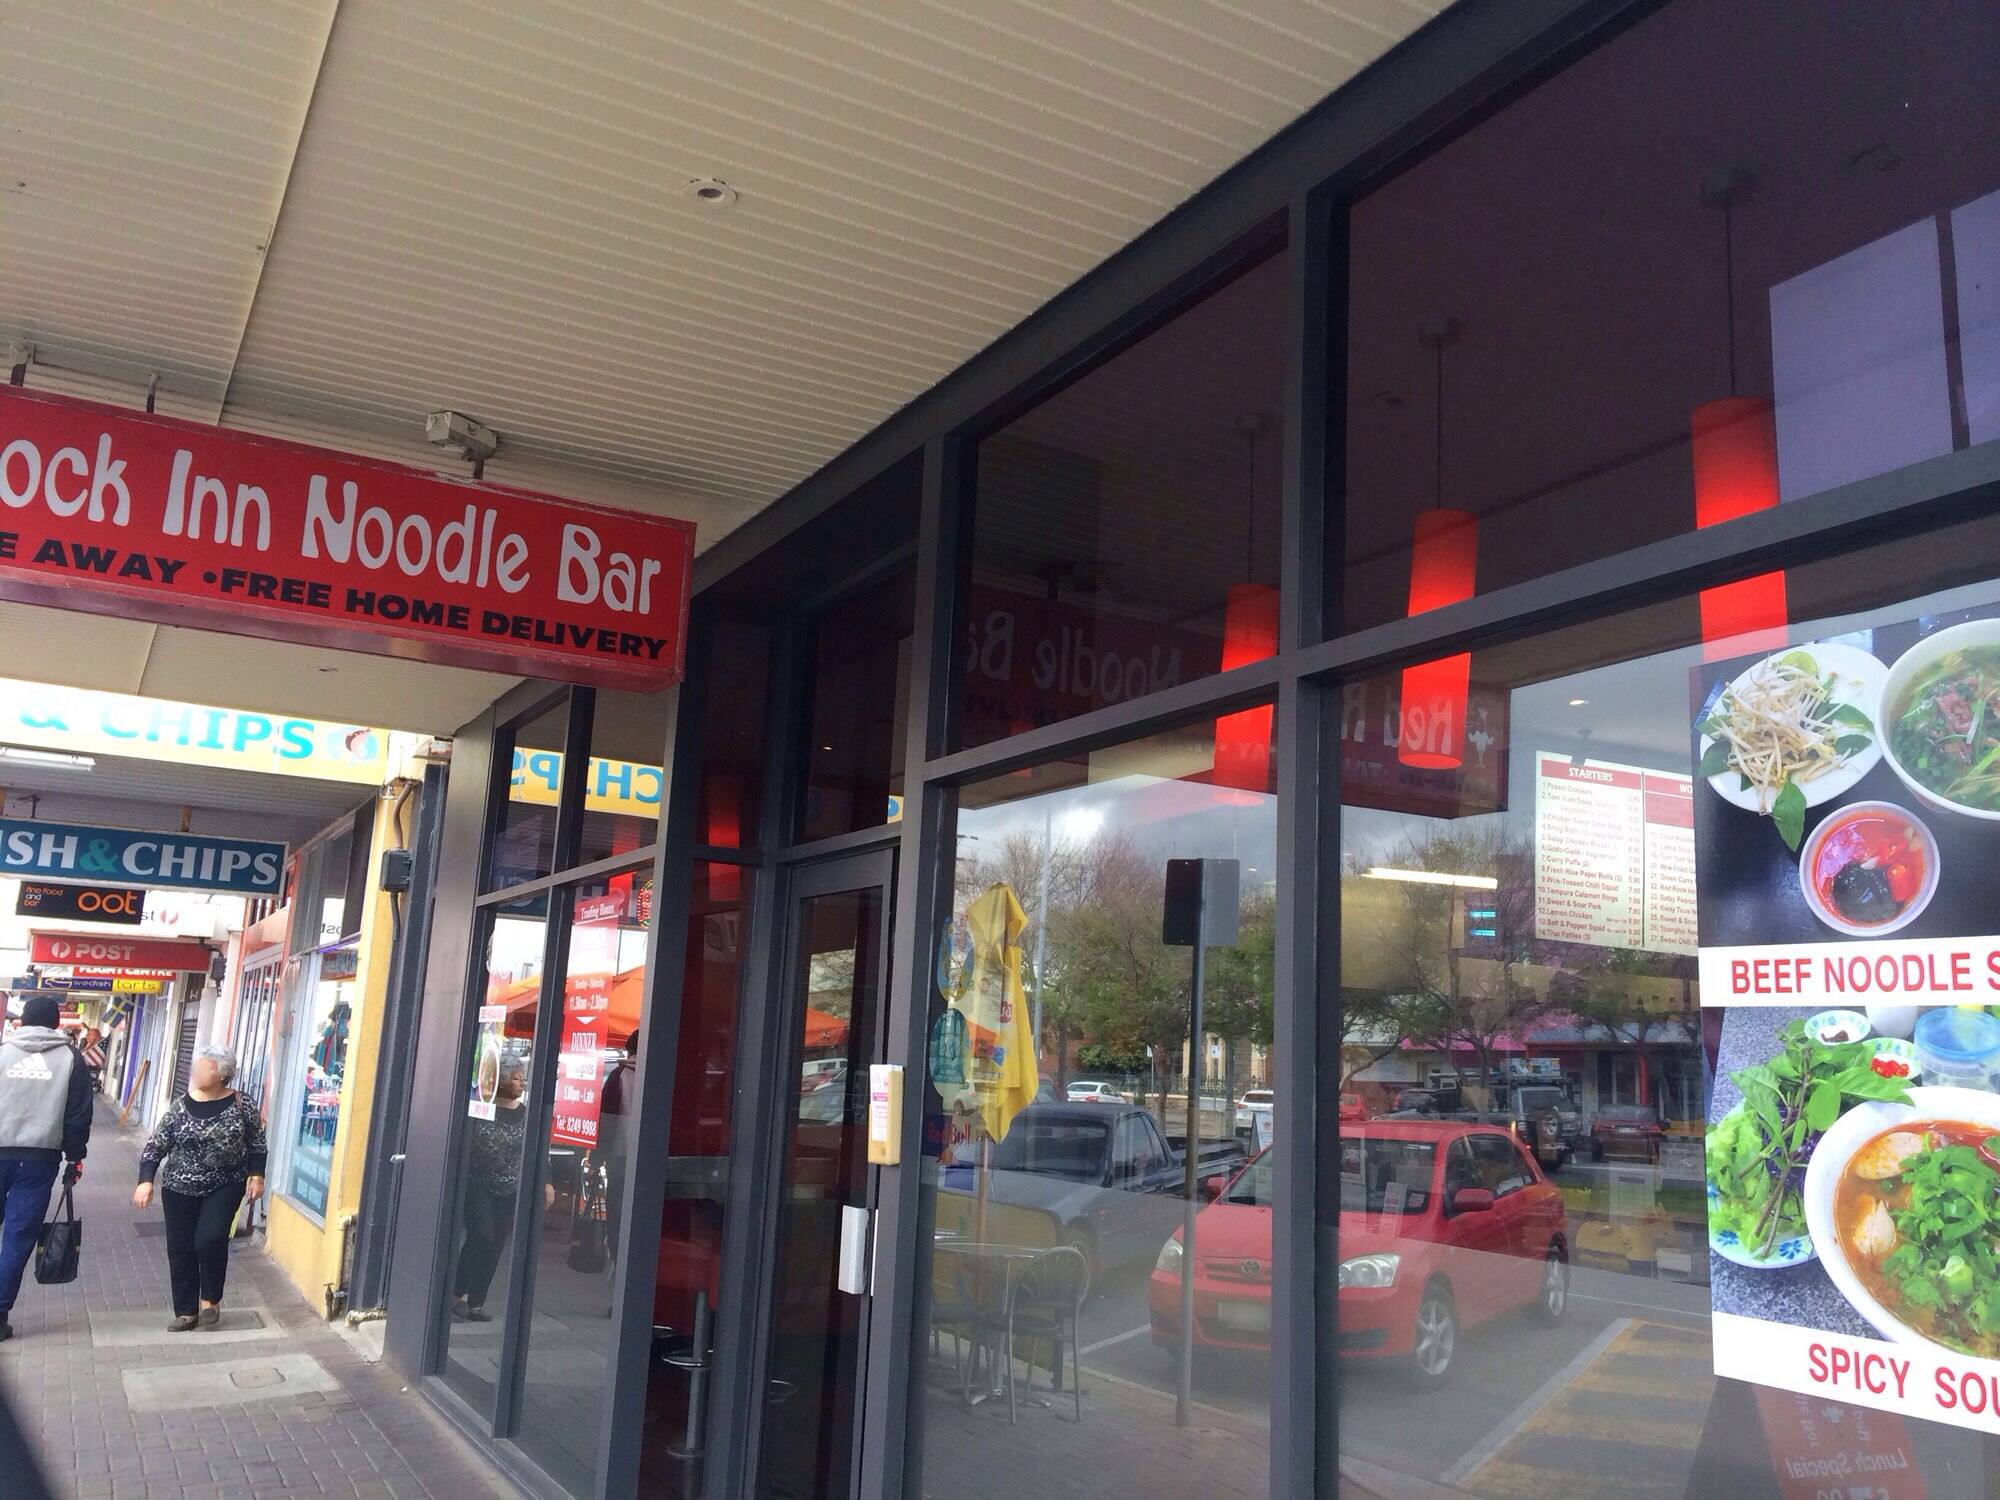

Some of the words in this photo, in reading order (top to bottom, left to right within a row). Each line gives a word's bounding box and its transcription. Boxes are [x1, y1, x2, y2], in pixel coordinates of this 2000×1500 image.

[162, 449, 271, 551] Inn
[301, 474, 530, 593] Noodle
[557, 523, 661, 615] Bar
[32, 539, 187, 584] AWAY
[344, 588, 470, 632] HOME
[481, 610, 669, 660] DELIVERY
[101, 701, 315, 760] CHIPS
[1569, 768, 1613, 782] STARTERS
[77, 890, 138, 915] oot
[75, 943, 136, 961] POST
[1731, 958, 1812, 994] BEEF
[1823, 952, 1973, 994] NOODLE
[116, 979, 156, 991] tarts
[1808, 1342, 1910, 1398] SPICY
